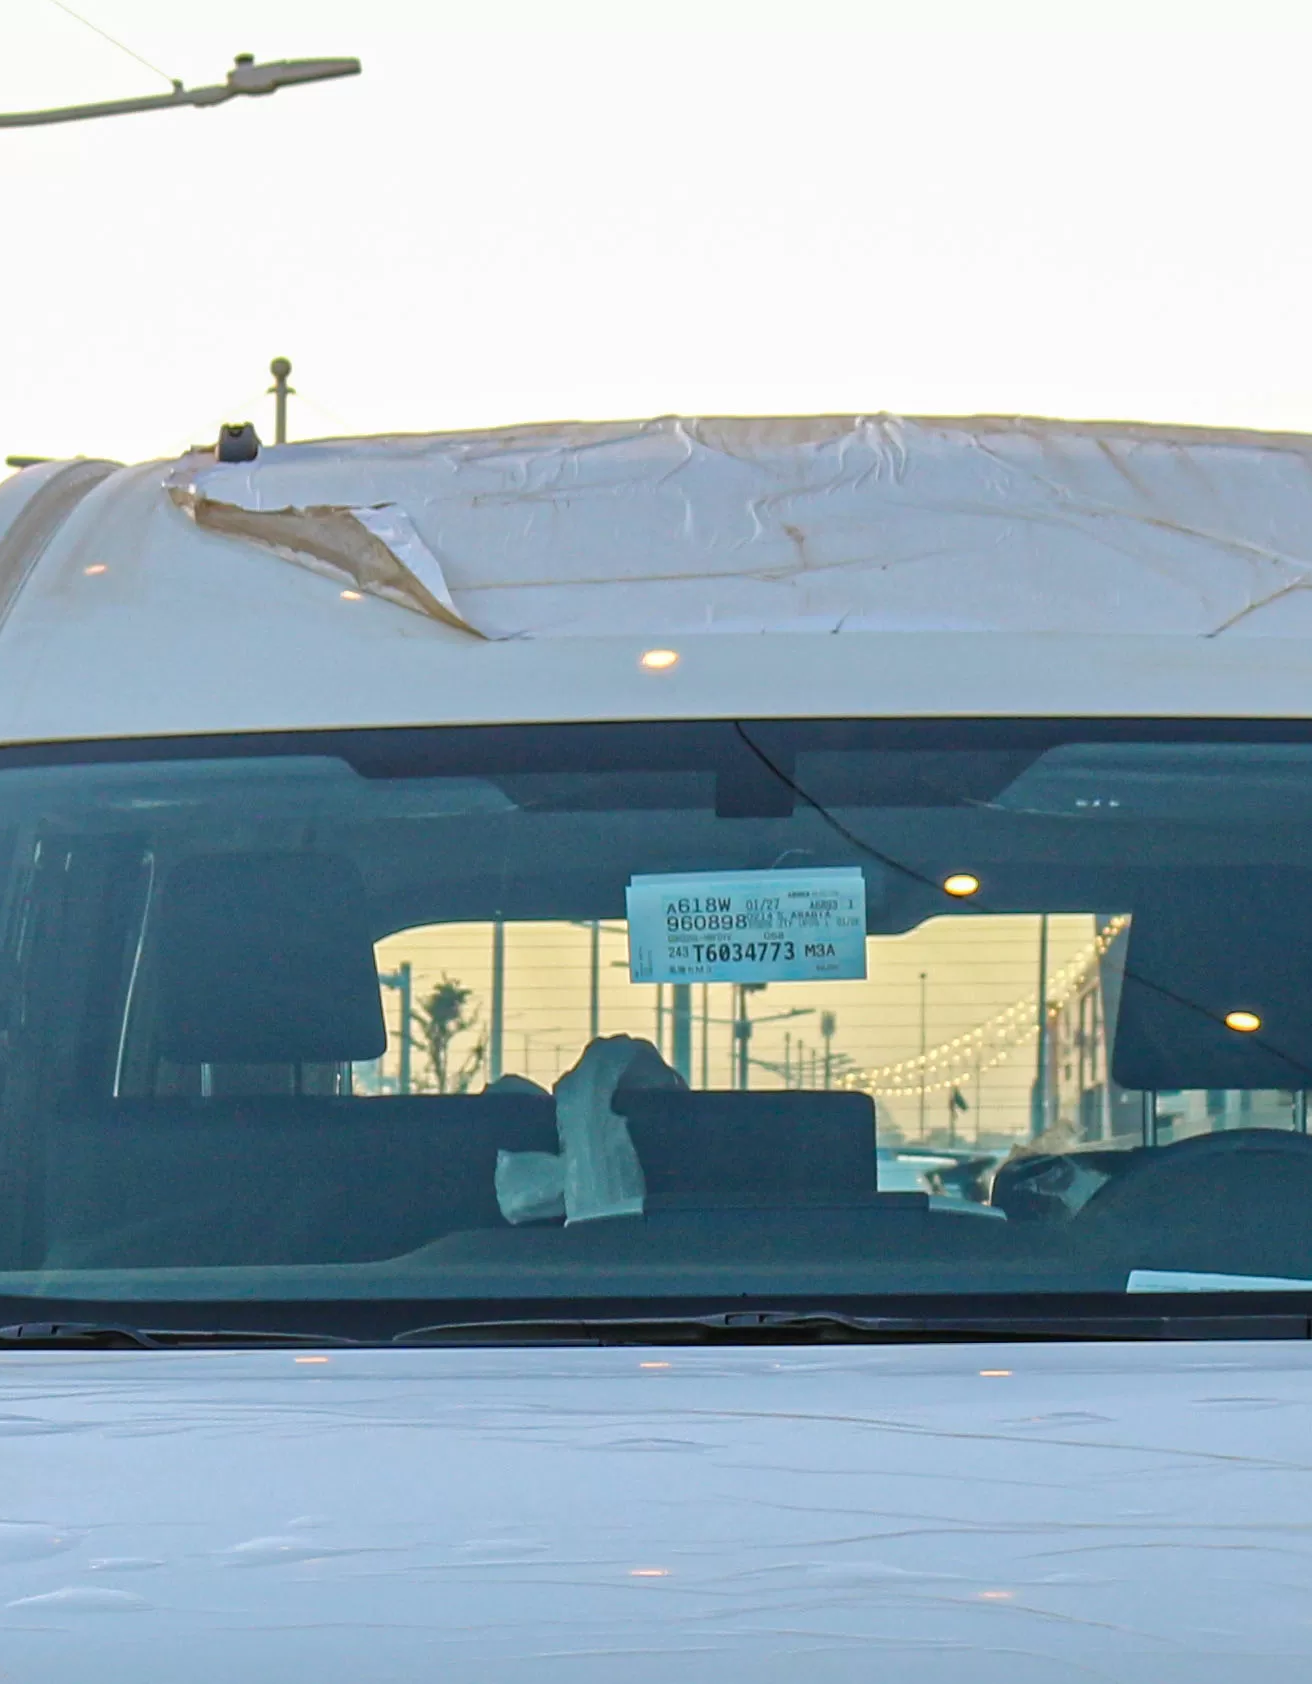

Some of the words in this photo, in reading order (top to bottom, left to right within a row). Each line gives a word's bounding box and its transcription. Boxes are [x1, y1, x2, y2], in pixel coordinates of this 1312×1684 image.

[667, 897, 731, 914] A618W
[745, 898, 780, 911] 01/27
[667, 914, 748, 932] 960898
[668, 946, 689, 958] 243
[692, 941, 796, 963] T6034773
[804, 944, 836, 957] M3A
